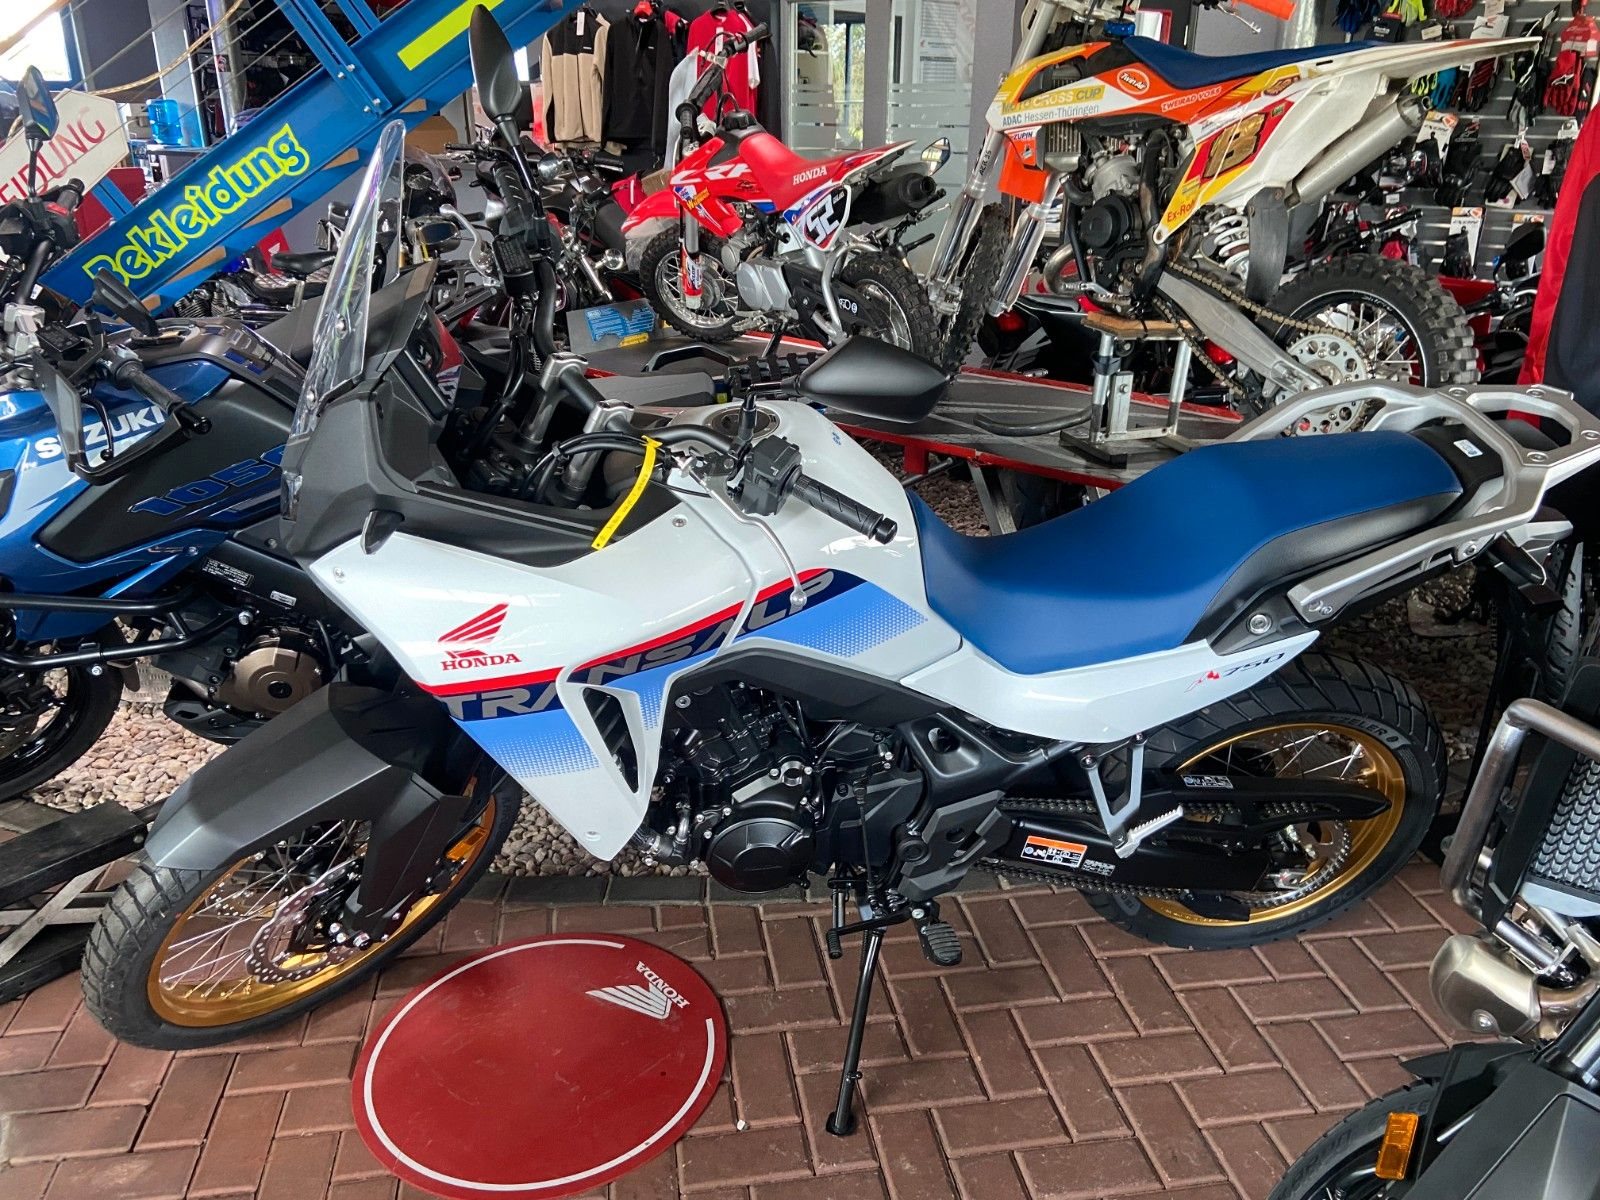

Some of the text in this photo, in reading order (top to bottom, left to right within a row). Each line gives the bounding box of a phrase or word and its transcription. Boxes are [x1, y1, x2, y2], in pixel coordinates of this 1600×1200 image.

[1076, 87, 1102, 101] CUP
[1002, 103, 1100, 128] ADAC Hessen-Thüringen
[792, 165, 829, 186] HONDA
[83, 124, 311, 286] Bekleidung
[34, 403, 165, 460] SZUKI
[440, 569, 836, 720] TRANSALP
[441, 652, 522, 672] HONDA
[635, 960, 691, 1009] HONDA
